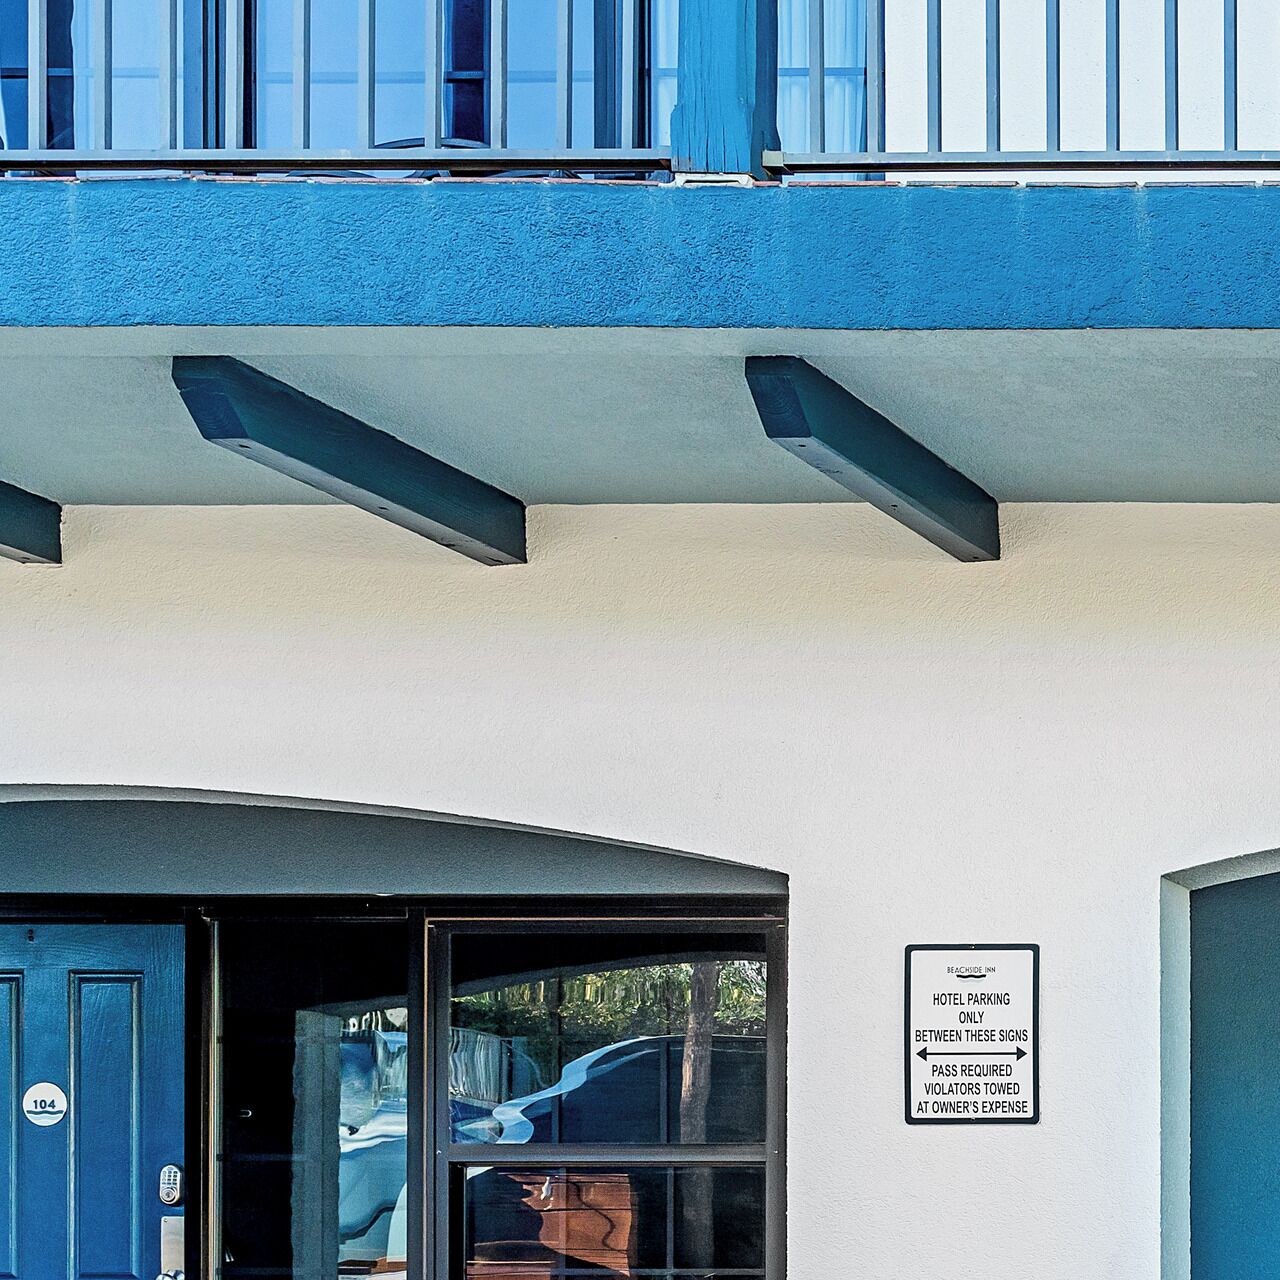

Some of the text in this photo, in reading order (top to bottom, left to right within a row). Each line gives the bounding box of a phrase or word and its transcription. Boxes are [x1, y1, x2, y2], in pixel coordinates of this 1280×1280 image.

[947, 966, 996, 974] BEACHSIDE INN
[933, 993, 1010, 1005] HOTEL PARKING
[959, 1011, 984, 1024] ONLY
[916, 1029, 1028, 1042] BETWEEN THESE SIGNS
[932, 1064, 1012, 1077] PASS REQUIRED
[924, 1083, 1019, 1095] VIOLATORS TOWED
[33, 1099, 56, 1109] 104
[917, 1101, 1028, 1113] AT OWNER'S EXPENSE
